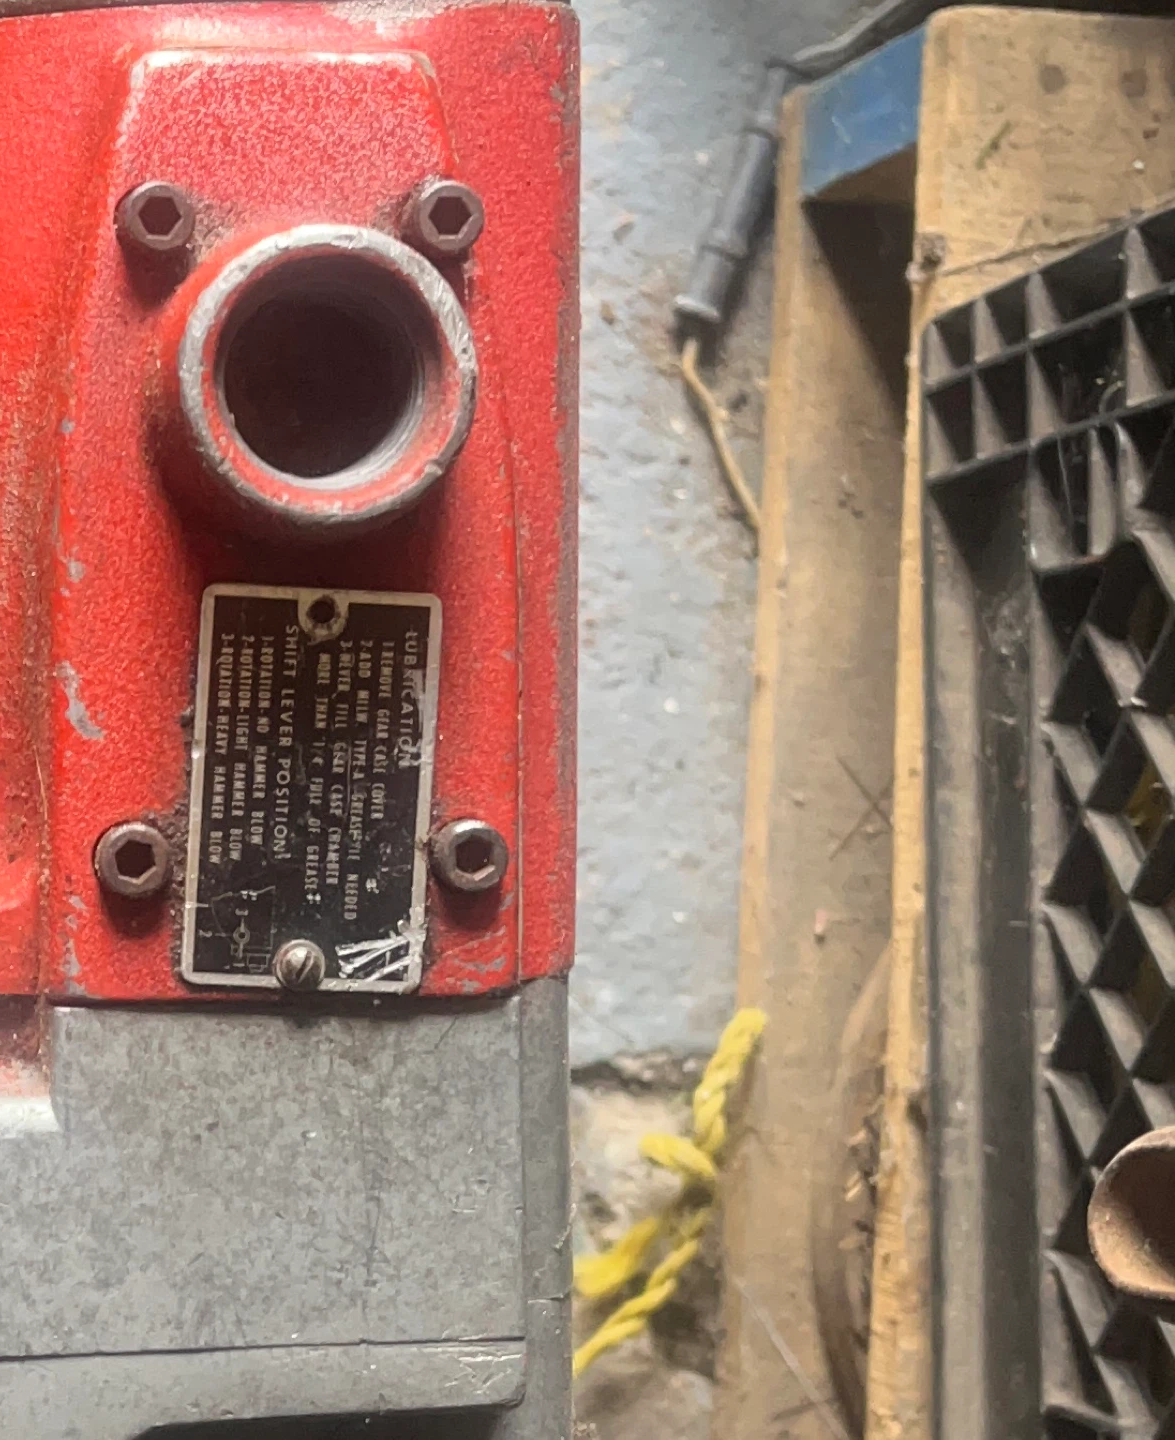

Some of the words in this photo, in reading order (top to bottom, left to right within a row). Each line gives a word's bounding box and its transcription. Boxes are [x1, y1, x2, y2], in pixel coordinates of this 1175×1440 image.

[283, 625, 298, 678] SHIFT
[318, 654, 331, 686] MORE
[314, 697, 329, 729] THAN
[335, 704, 347, 729] FILL
[399, 632, 418, 767] LUBRICATION
[279, 689, 295, 746] LEVER
[376, 710, 391, 739] GEAR
[253, 746, 267, 799] HAMMER
[331, 743, 346, 774] GEAR
[373, 747, 388, 775] CASE
[213, 766, 228, 819] HAMMER
[232, 763, 247, 816] HAMMER
[274, 758, 291, 852] POSITION
[329, 785, 343, 815] CASE
[371, 783, 384, 819] COVER
[250, 810, 264, 845] BLOW
[307, 818, 322, 833] OF
[209, 832, 224, 864] BLOW
[230, 828, 244, 860] BLOW
[326, 827, 342, 885] CHAMBER
[305, 845, 320, 890] GREASE
[344, 874, 358, 920] NEEDED
